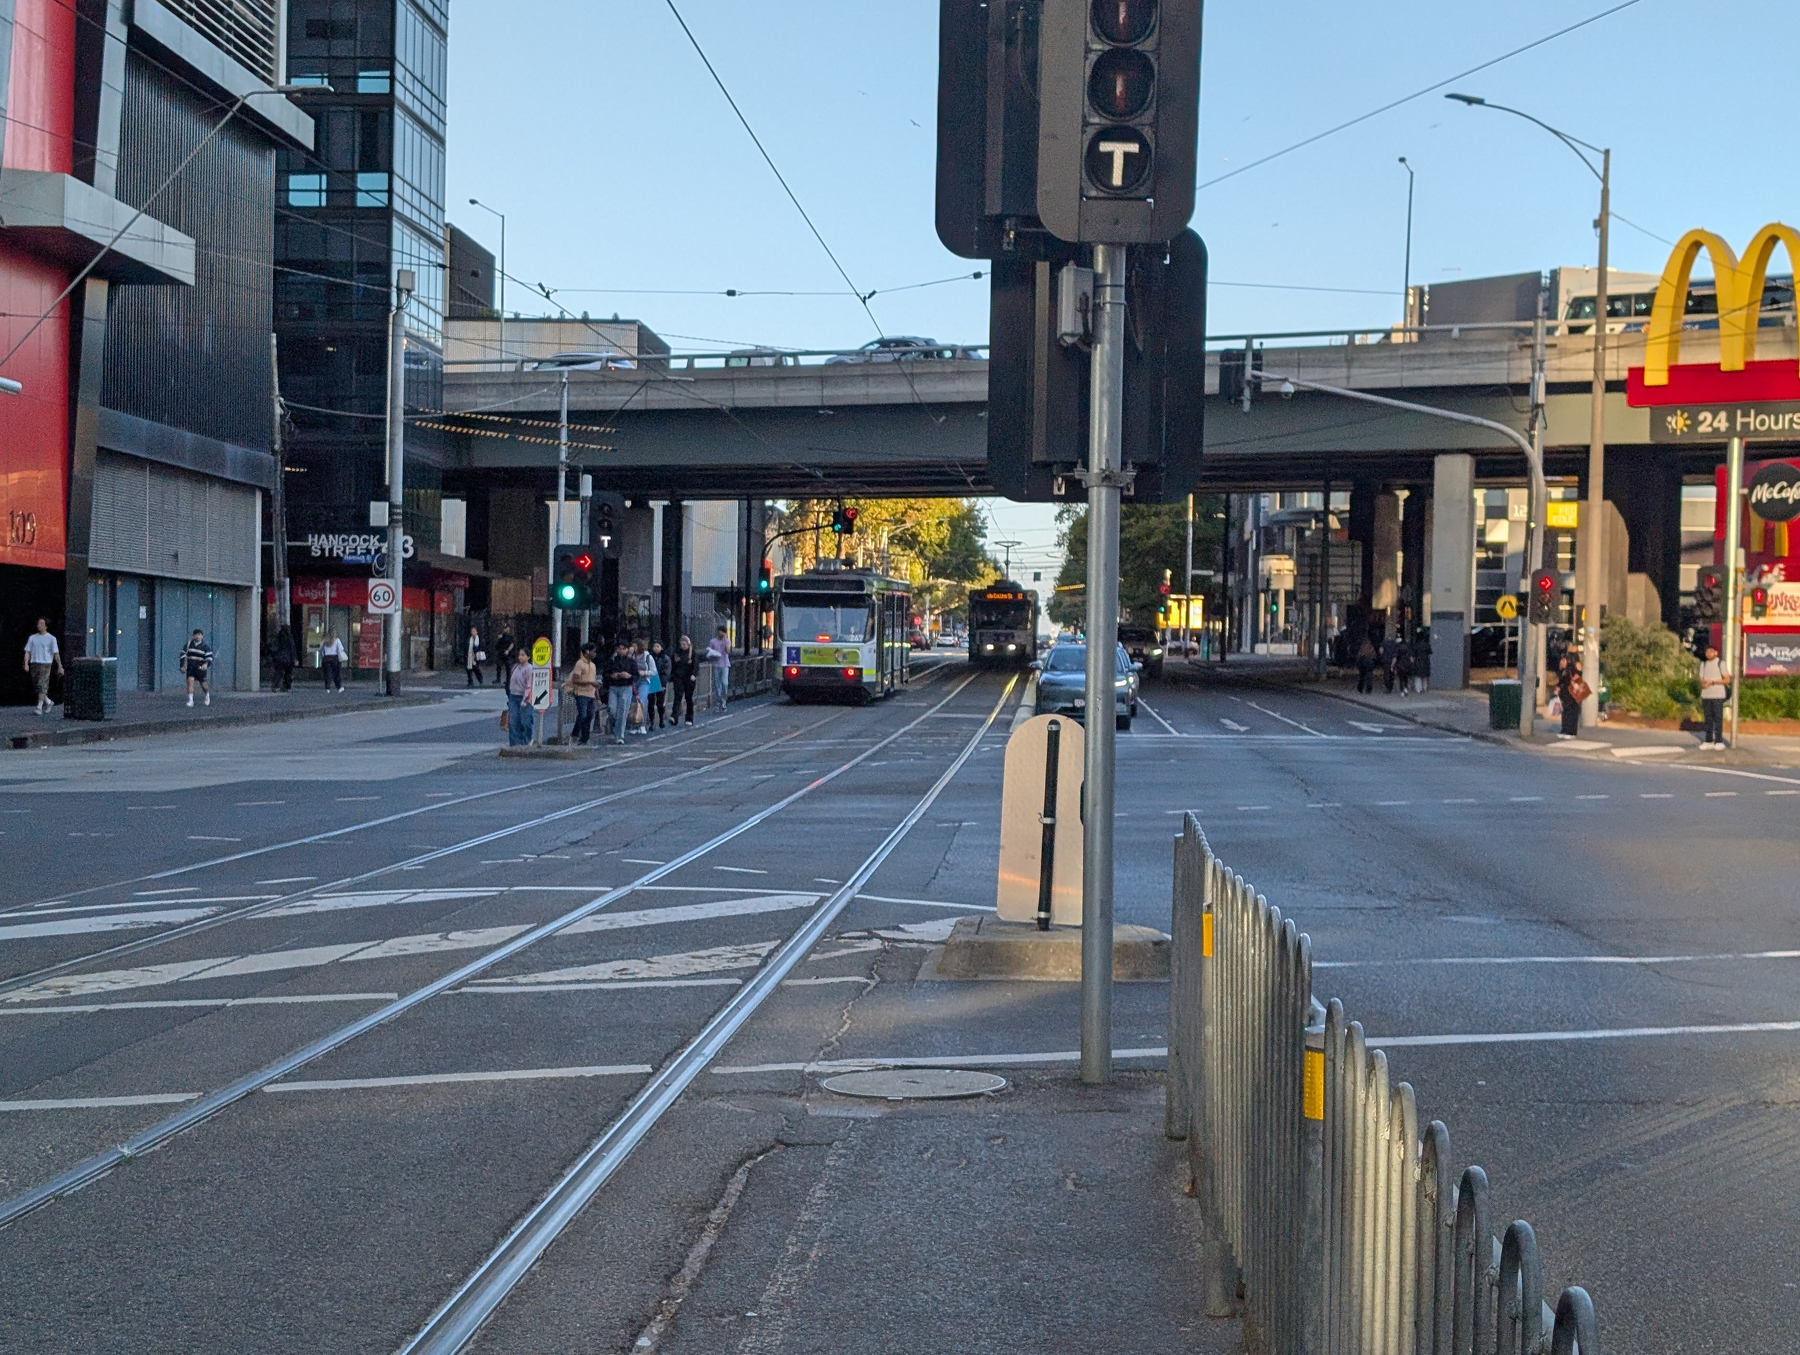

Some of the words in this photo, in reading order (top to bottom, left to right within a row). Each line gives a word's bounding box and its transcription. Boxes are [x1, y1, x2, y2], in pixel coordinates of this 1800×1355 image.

[1697, 410, 1730, 433] 24
[1736, 408, 1800, 432] Hours
[308, 533, 380, 548] HANCOCK
[311, 545, 378, 557] STREET
[373, 590, 391, 602] 60
[535, 645, 549, 653] SAFETY
